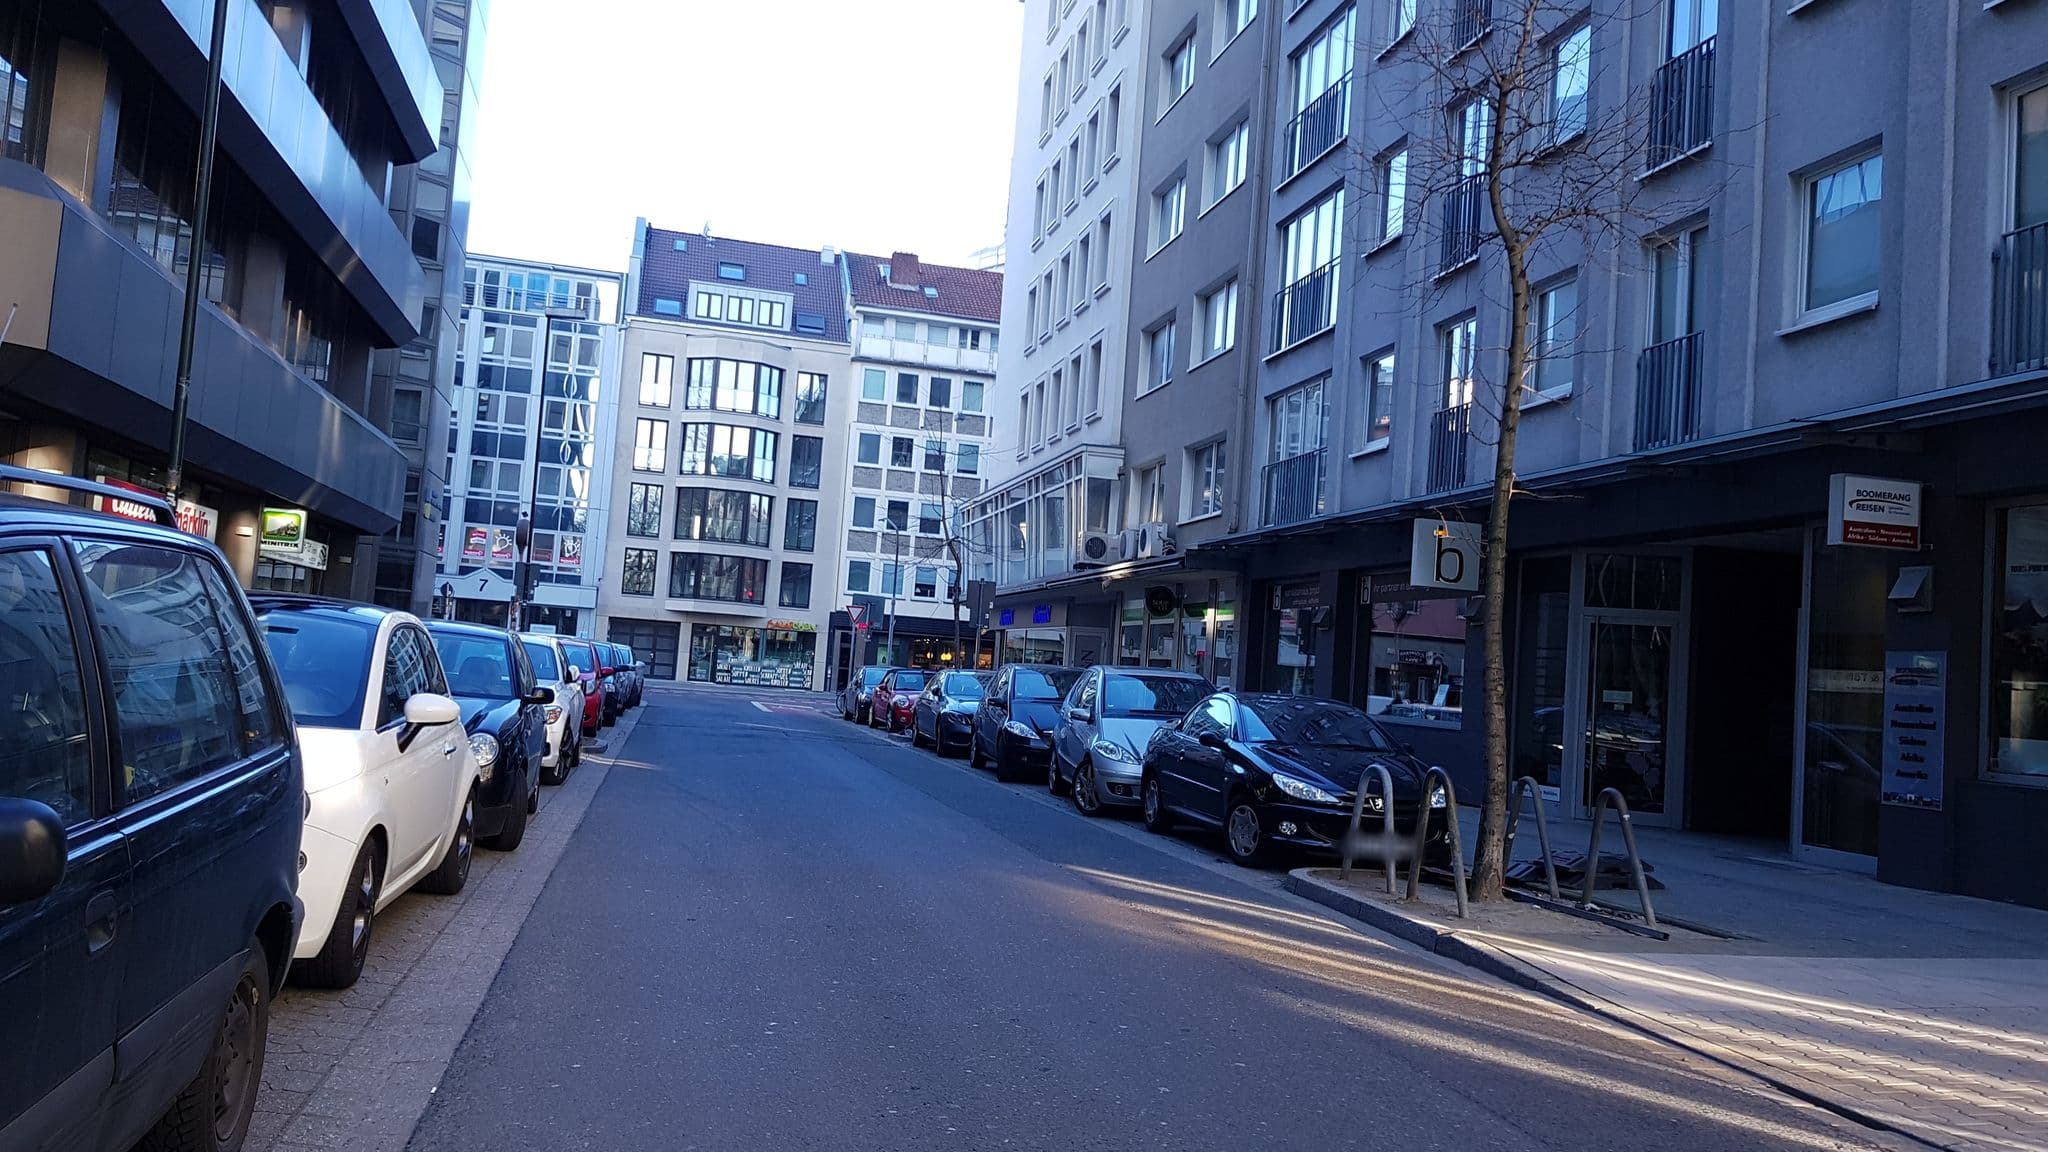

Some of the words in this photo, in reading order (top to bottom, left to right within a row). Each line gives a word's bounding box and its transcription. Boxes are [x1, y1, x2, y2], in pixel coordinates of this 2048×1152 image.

[1856, 489, 1911, 502] BOOMERANG
[1855, 503, 1885, 513] REISEN
[261, 540, 299, 548] MINITRIX
[1434, 525, 1464, 583] b
[479, 579, 488, 591] 7
